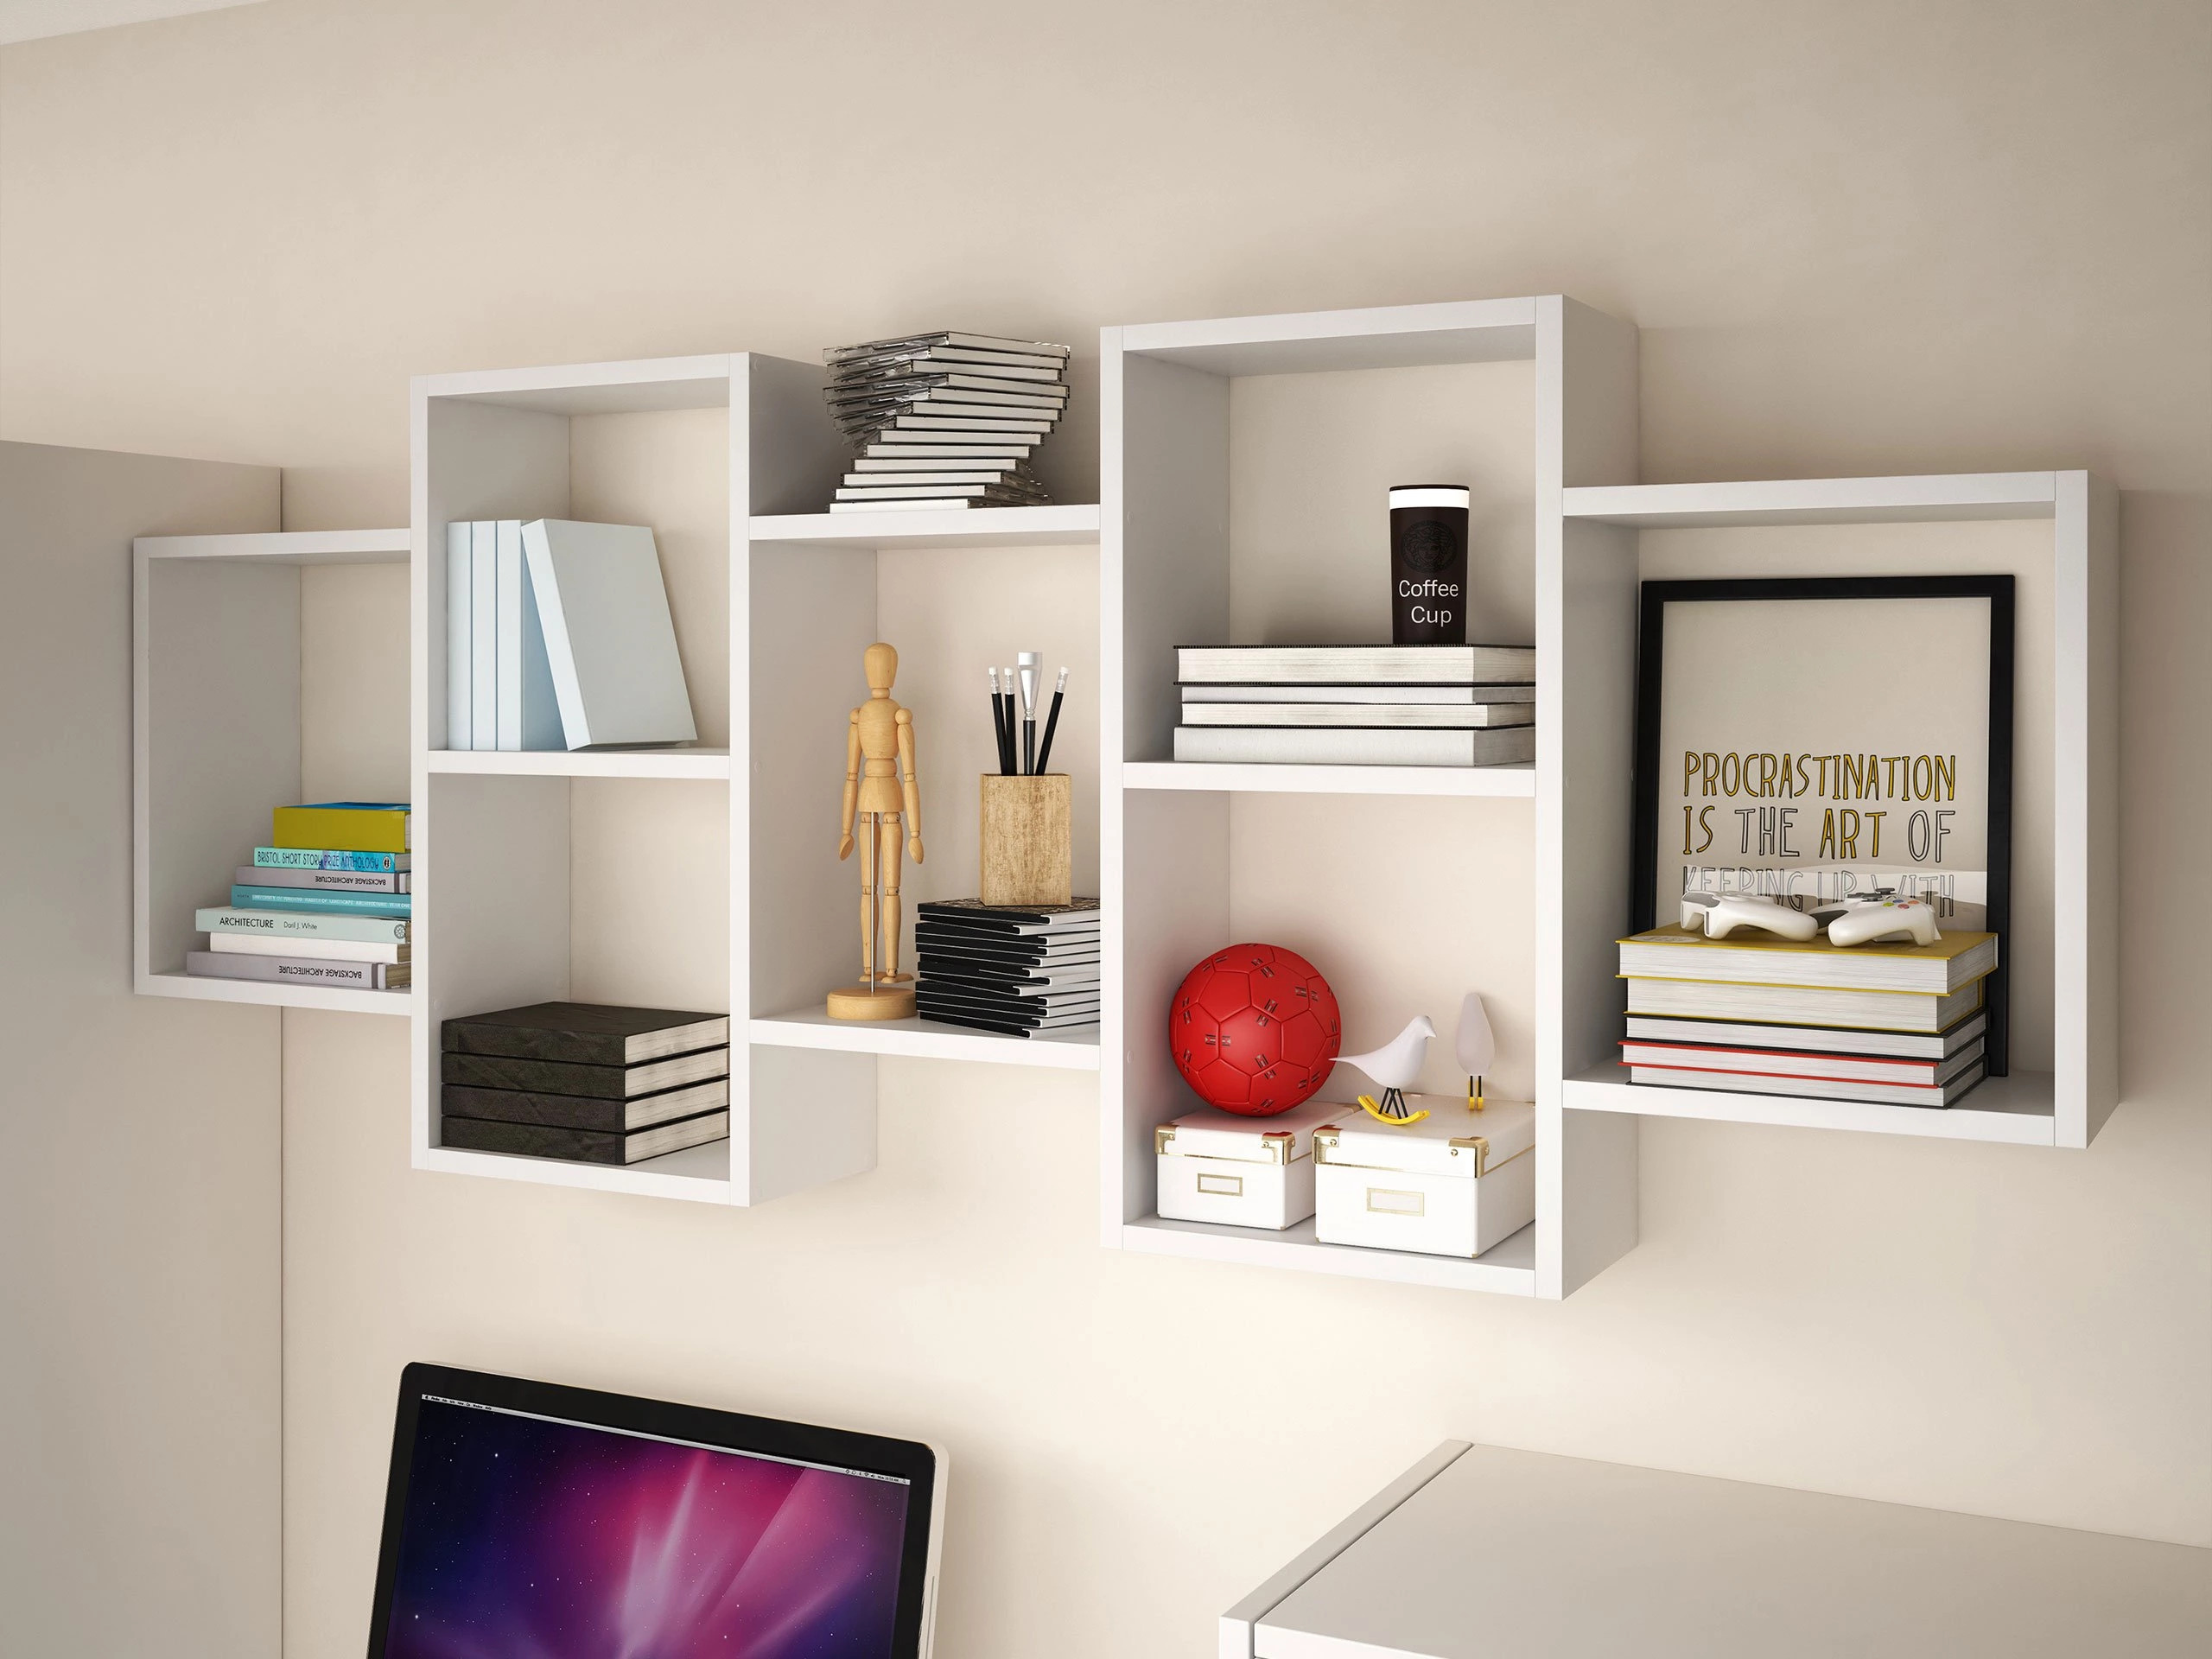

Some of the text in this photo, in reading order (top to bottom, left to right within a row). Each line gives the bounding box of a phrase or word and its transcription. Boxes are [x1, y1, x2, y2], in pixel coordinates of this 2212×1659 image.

[1398, 579, 1459, 598] Coffee
[1410, 605, 1452, 627] Cup
[1683, 751, 1955, 802] PROCRASTINATION
[1682, 805, 1956, 863] IS THE ART OF
[257, 850, 281, 864] BRISTOL
[282, 852, 302, 865] SHORT
[315, 875, 386, 886] BACKSTAGE ARCHITECTURE
[219, 917, 274, 929] ARCHITECTURE
[302, 922, 318, 931] White
[278, 964, 362, 979] BACKSTAGE ARCHITECTURE
